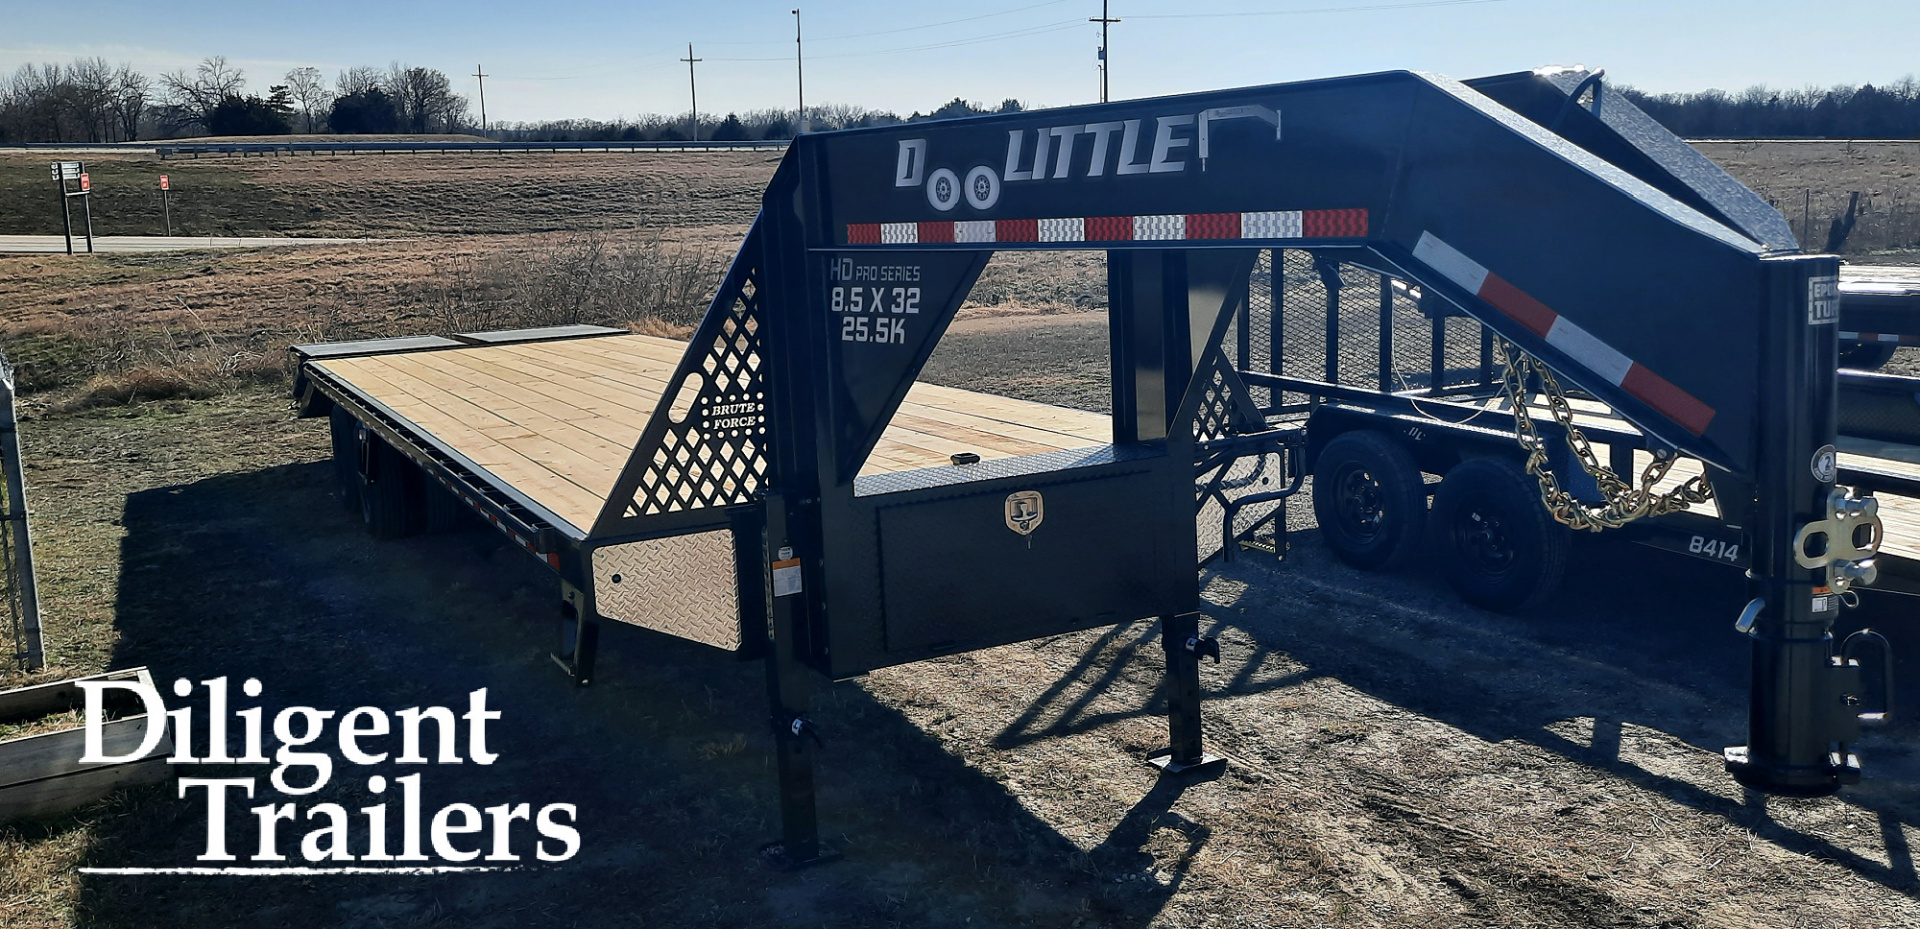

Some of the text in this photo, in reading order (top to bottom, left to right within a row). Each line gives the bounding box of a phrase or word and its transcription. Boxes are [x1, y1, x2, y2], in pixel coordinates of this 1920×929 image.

[830, 258, 920, 281] HD PRO SERIES
[831, 287, 920, 314] 8.5 X 32
[842, 316, 905, 344] 25.5K
[711, 402, 755, 416] BRUTE
[713, 415, 756, 430] FORCE
[1689, 535, 1739, 562] 8414
